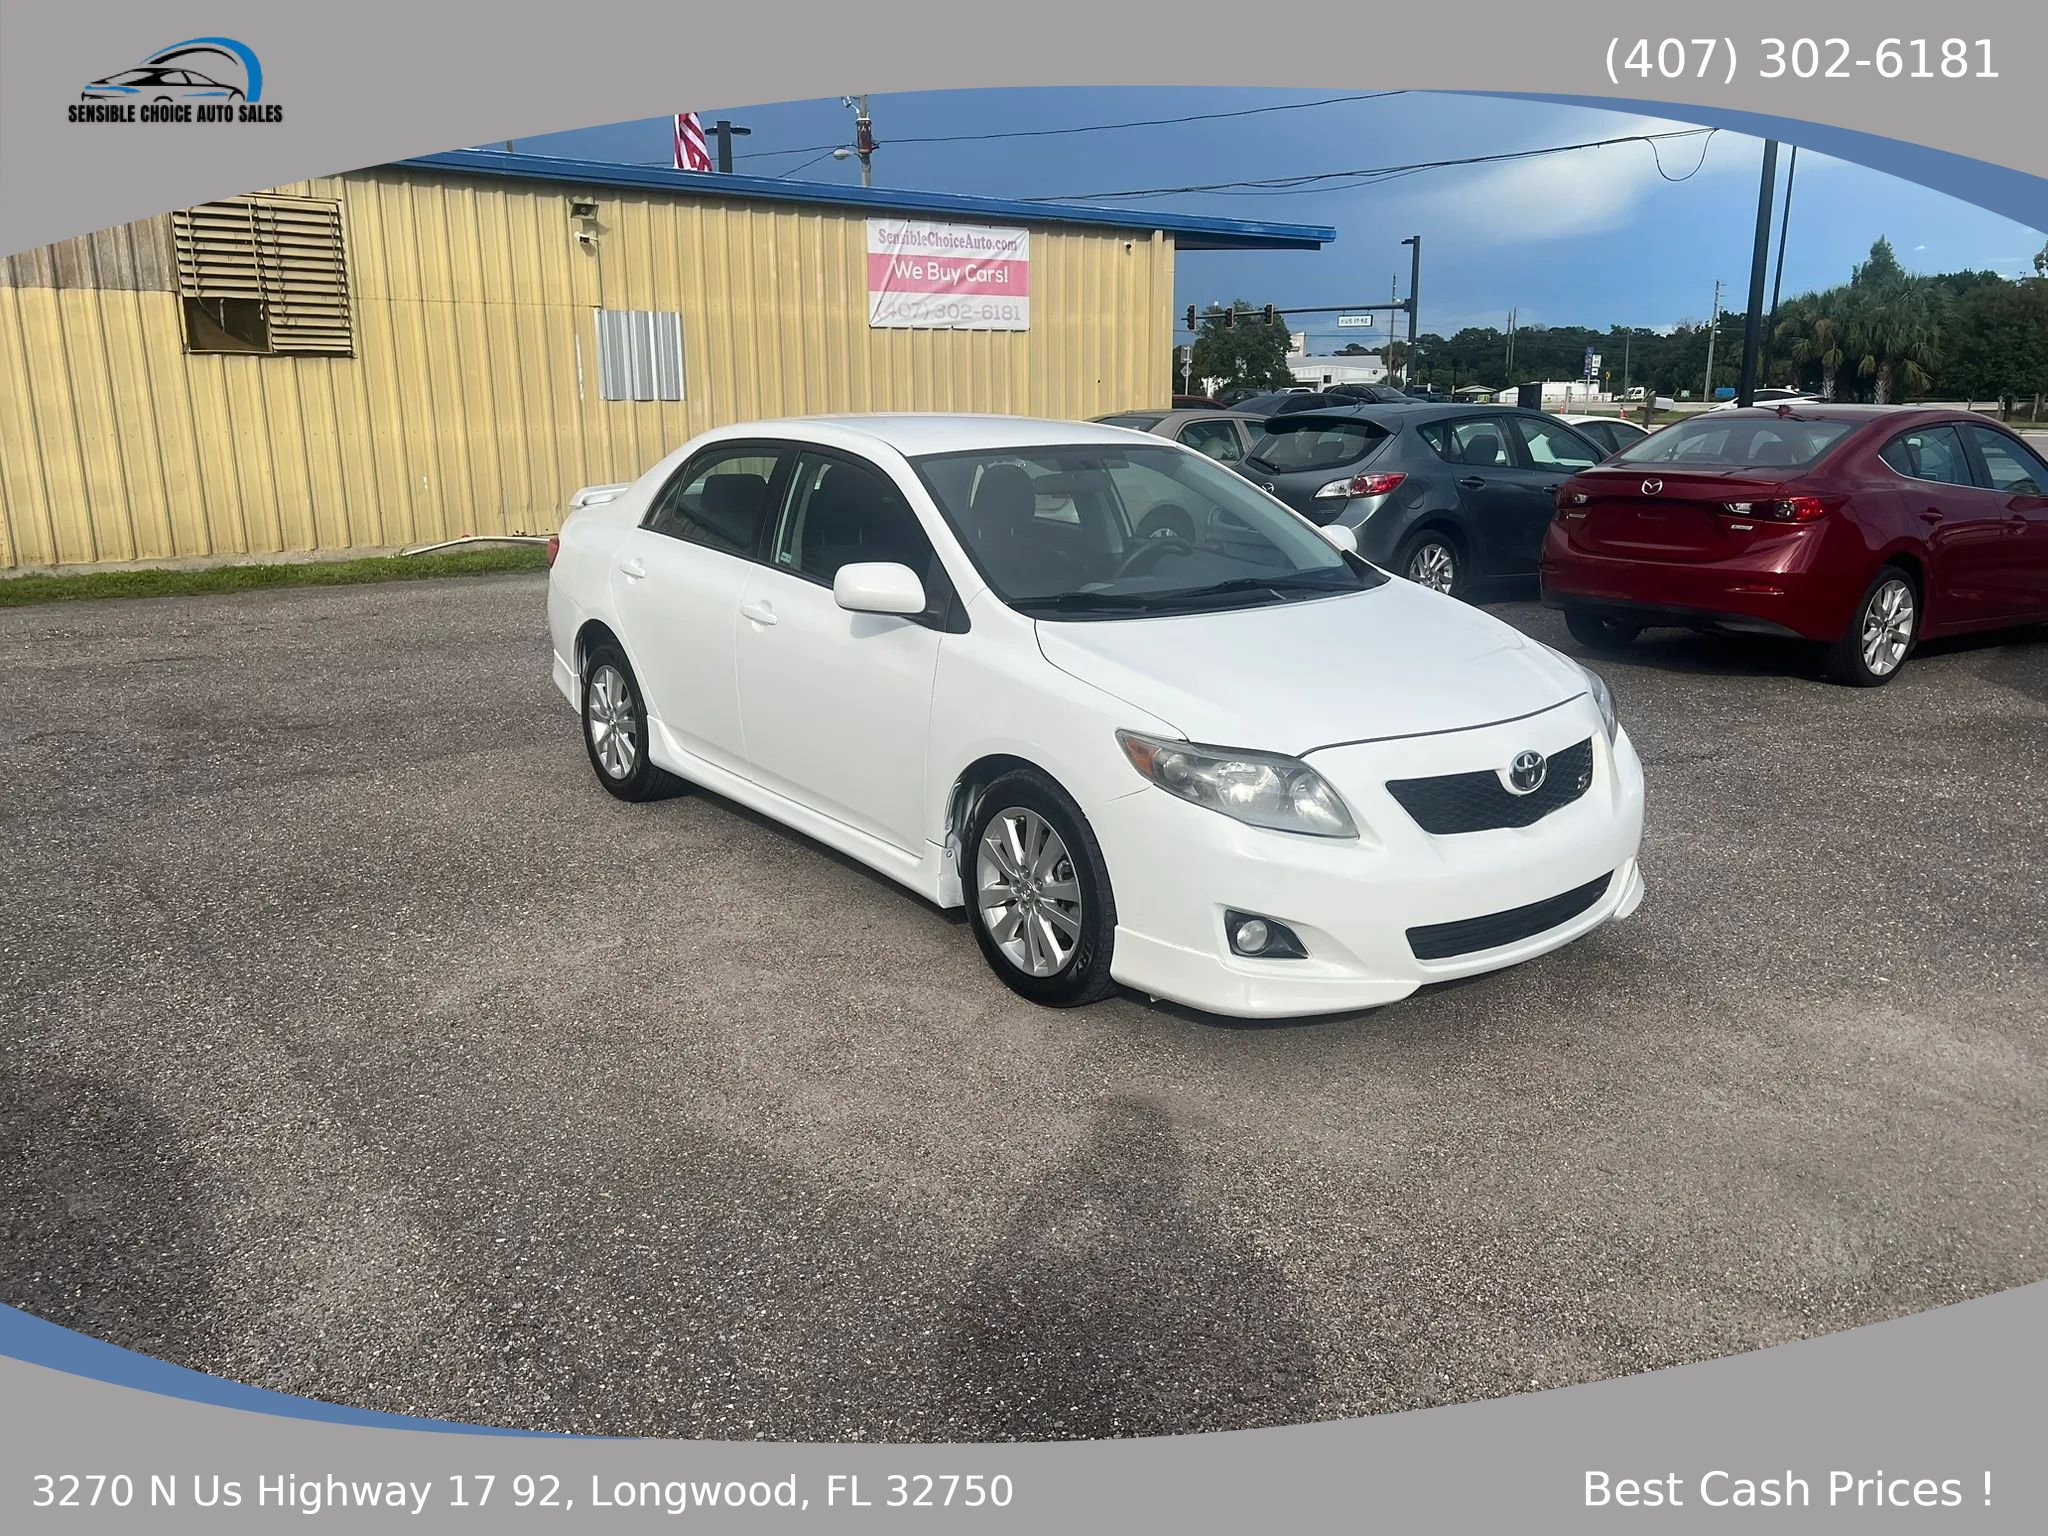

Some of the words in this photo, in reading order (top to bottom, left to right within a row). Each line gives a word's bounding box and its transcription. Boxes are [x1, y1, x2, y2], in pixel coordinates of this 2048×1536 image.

[894, 258, 923, 280] We
[927, 262, 961, 285] Buy
[965, 264, 1009, 284] Cars!
[876, 302, 929, 321] (407)
[934, 303, 1021, 321] 302-6181
